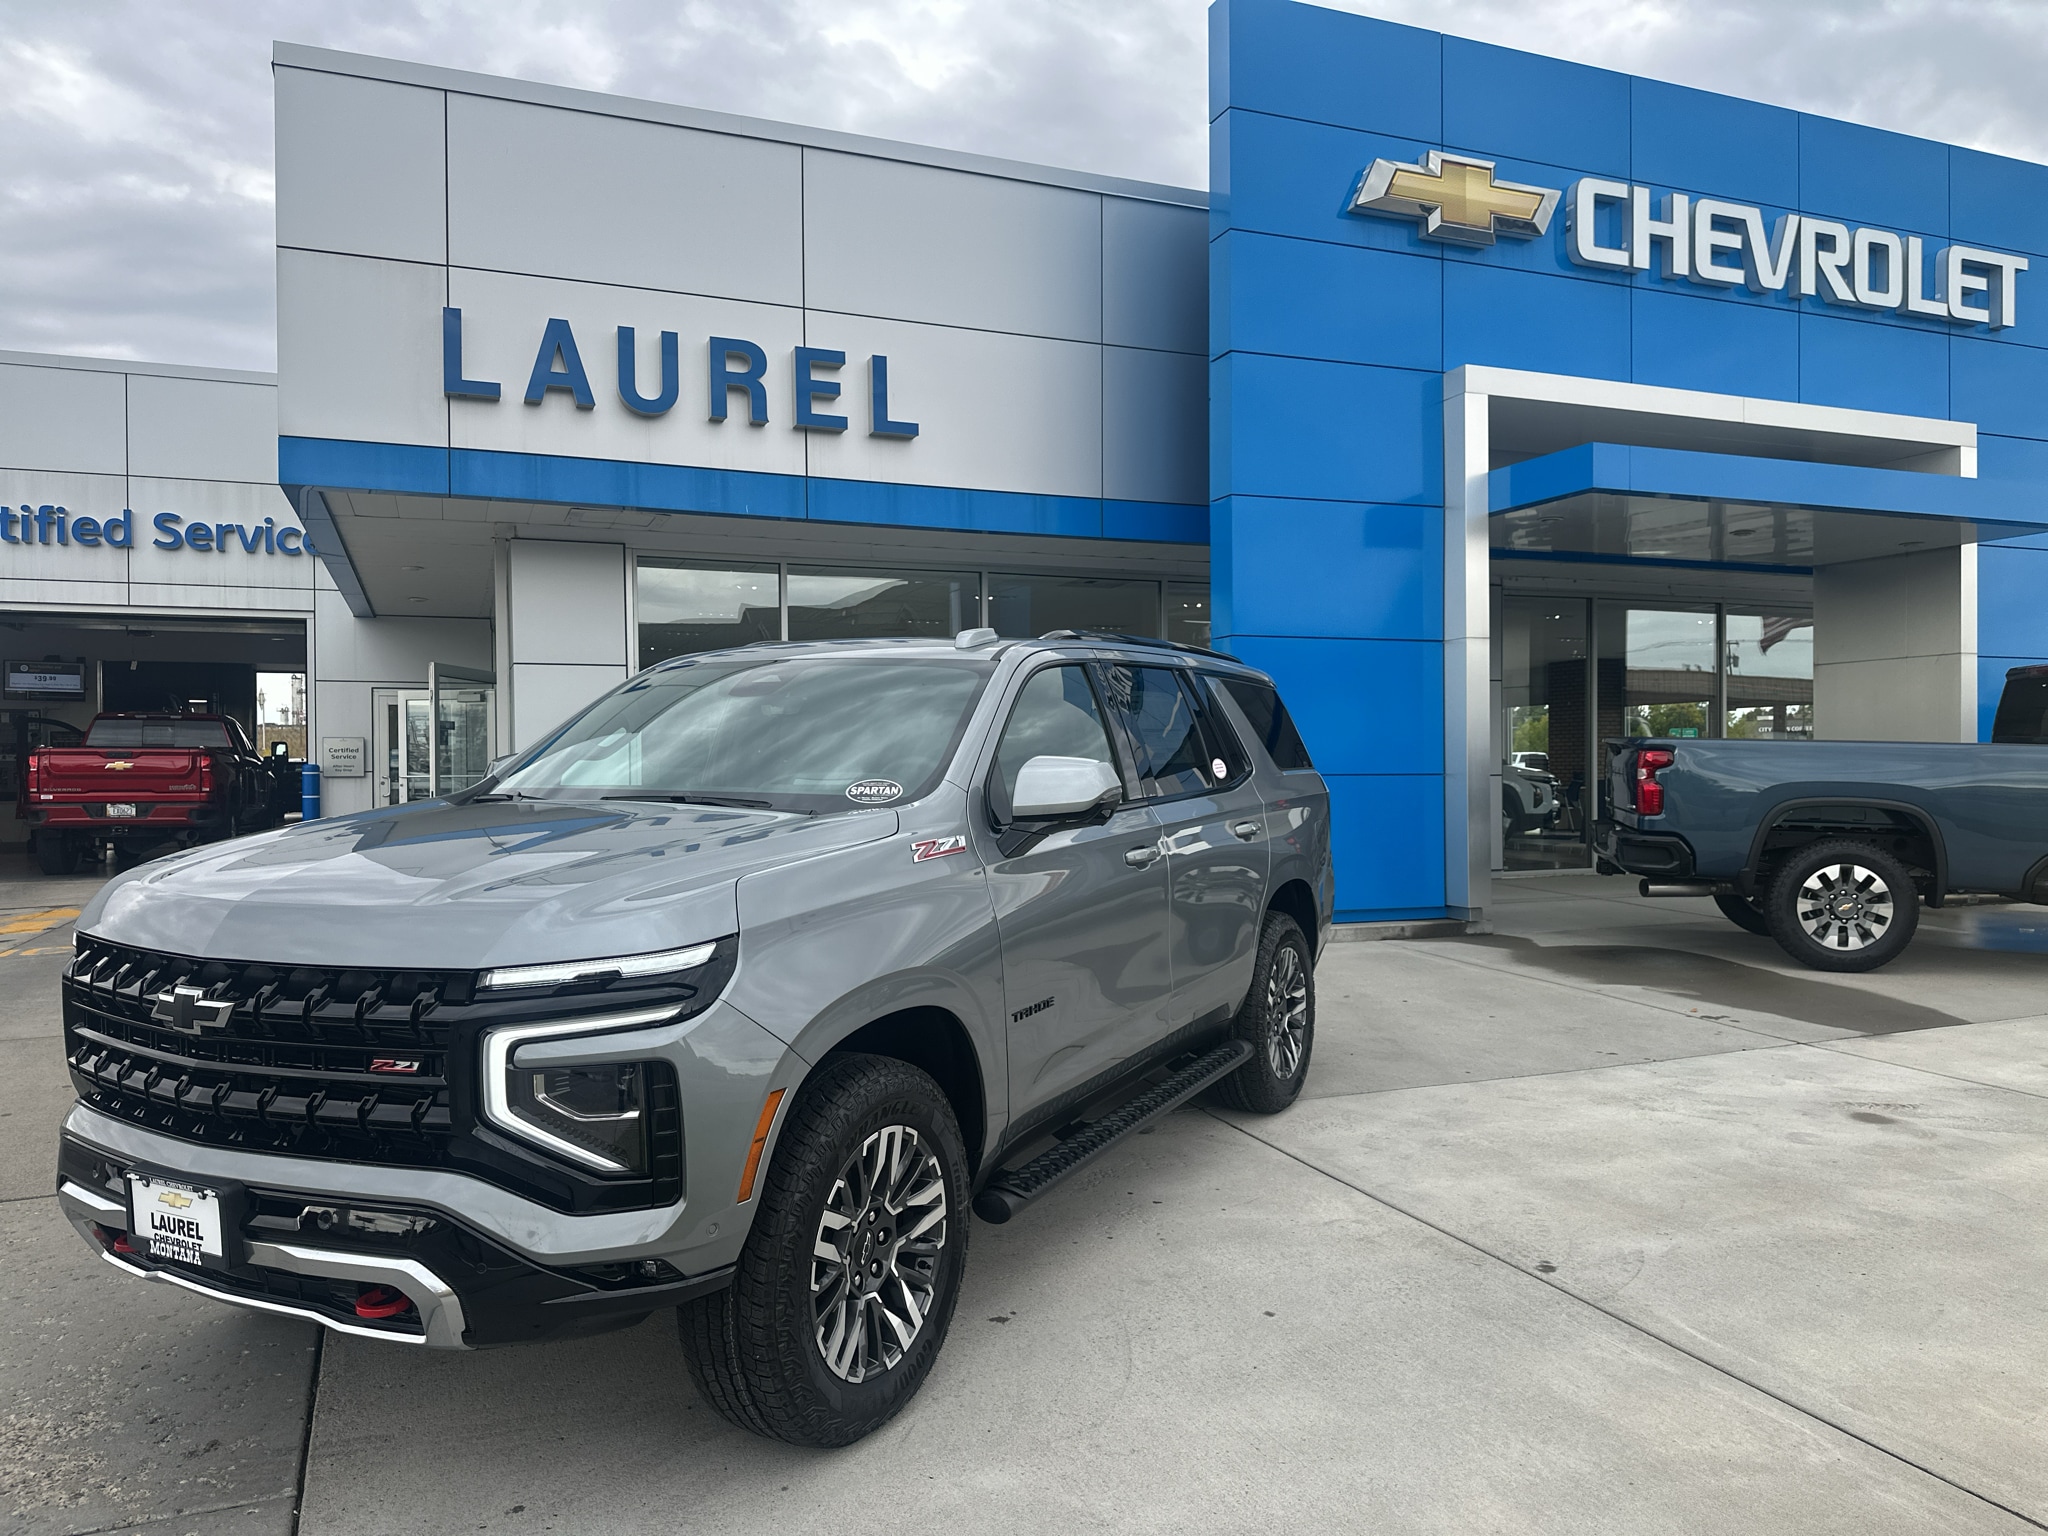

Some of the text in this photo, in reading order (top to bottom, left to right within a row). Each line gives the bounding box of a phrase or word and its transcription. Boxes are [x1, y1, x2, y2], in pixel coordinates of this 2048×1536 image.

[1567, 177, 2029, 330] CHEVROLET
[443, 306, 919, 440] LAUREL
[0, 504, 133, 548] tified
[850, 786, 899, 795] SPARTAN
[910, 835, 967, 864] Z71
[1011, 996, 1055, 1023] TAHOE
[370, 1059, 420, 1073] Z71
[151, 1212, 204, 1241] LAUREL
[149, 1239, 202, 1266] MONTANA
[154, 1233, 202, 1252] CHEVROLET
